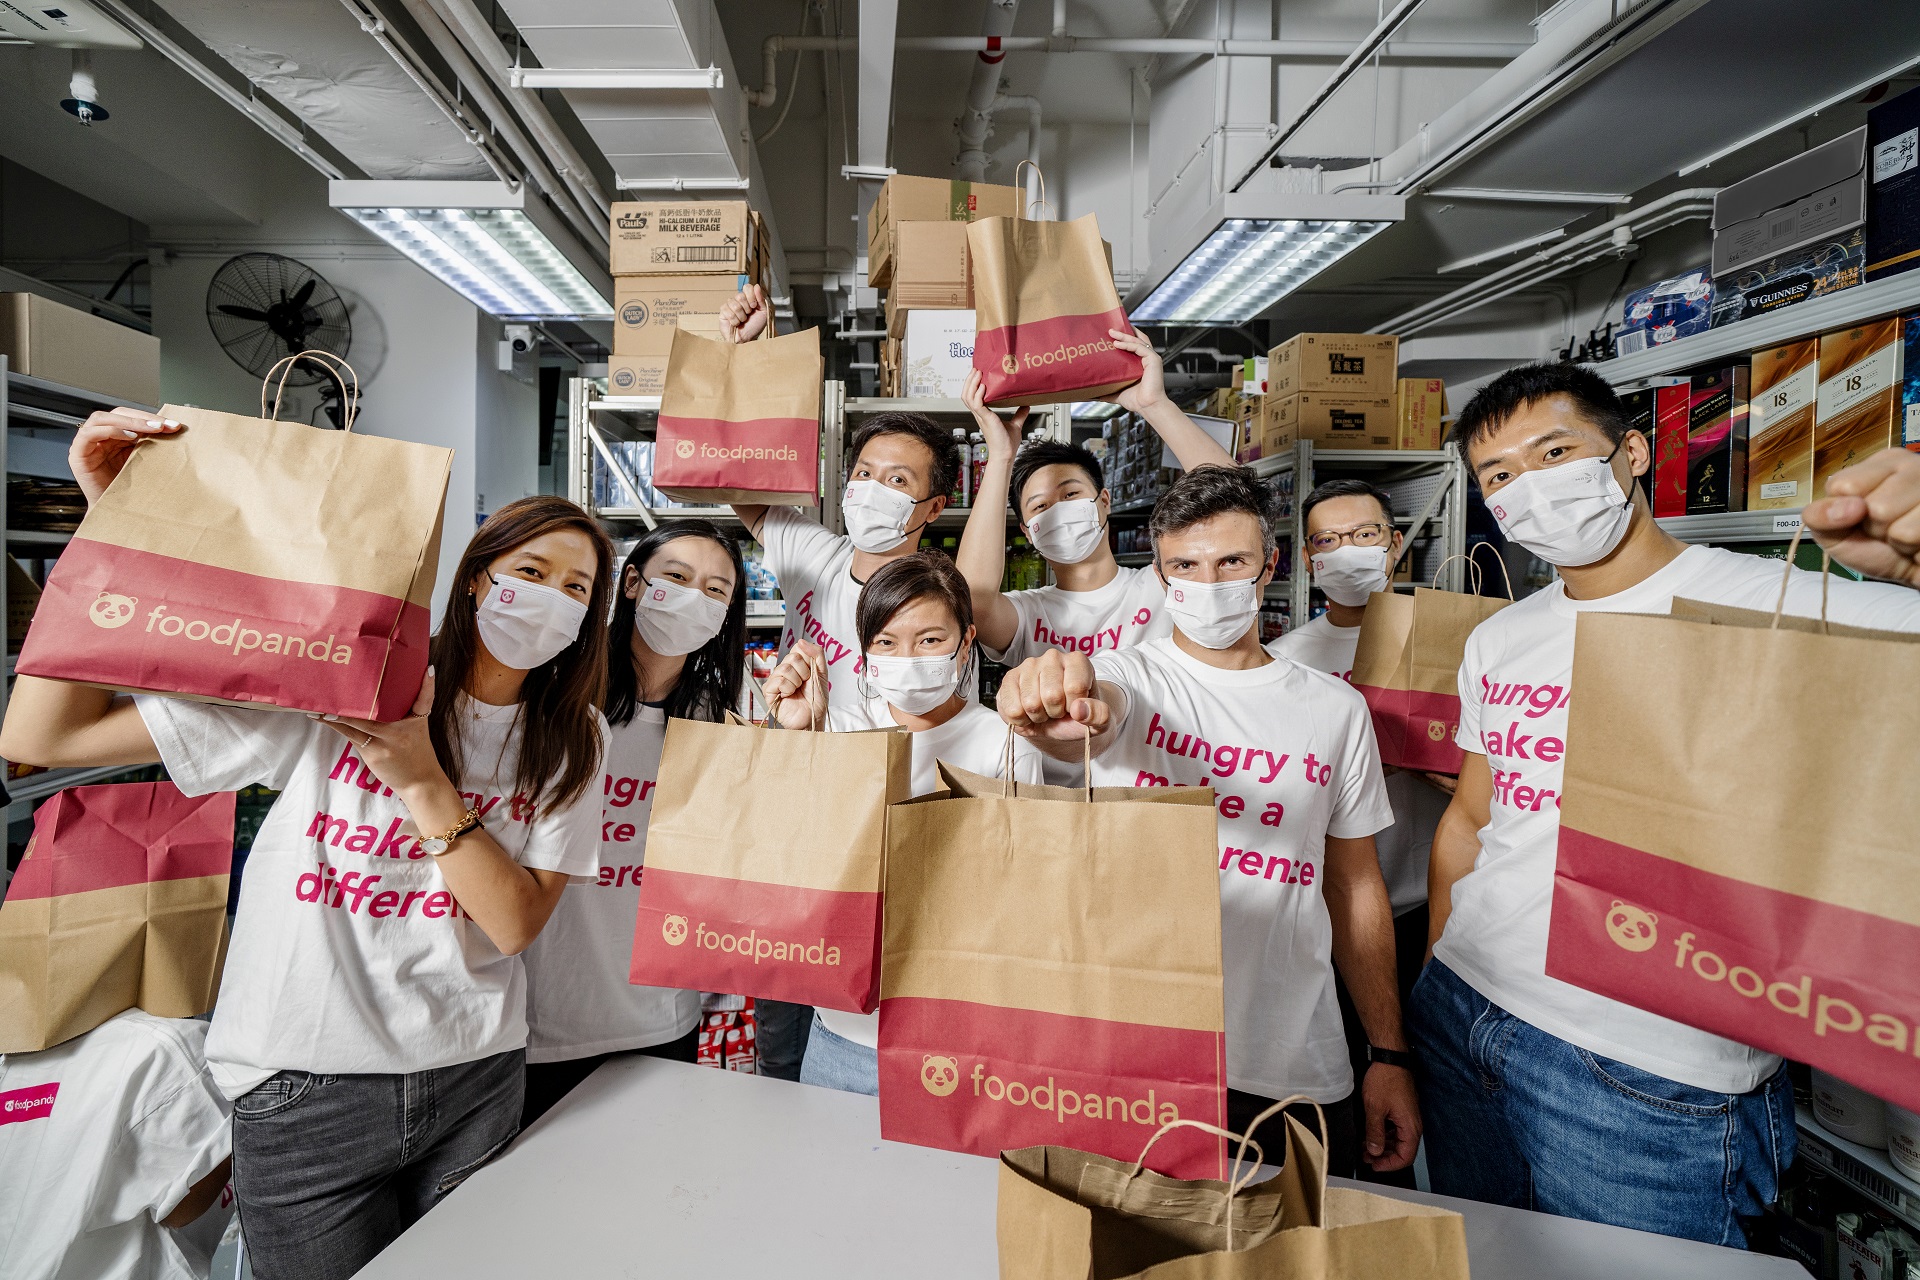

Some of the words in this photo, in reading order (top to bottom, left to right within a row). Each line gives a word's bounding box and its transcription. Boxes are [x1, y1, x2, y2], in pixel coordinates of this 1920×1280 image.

[620, 219, 643, 228] Pauls
[658, 224, 678, 232] MILK
[680, 223, 721, 231] BEVERAGE
[1760, 281, 1809, 304] GUINNESS
[949, 342, 974, 358] Hoe
[1023, 337, 1116, 370] foodpanda
[1846, 375, 1862, 392] 18
[1691, 409, 1709, 422] BLACK
[1711, 398, 1730, 411] LABEL
[1774, 392, 1787, 407] 18
[700, 443, 798, 464] foodpanda
[145, 605, 353, 665] foodpanda
[1145, 712, 1289, 784] hungry
[1303, 752, 1332, 787] to
[1481, 721, 1565, 762] ake
[1259, 801, 1284, 828] a
[695, 922, 841, 966] foodpanda
[1674, 931, 1920, 1059] foodpa
[970, 1063, 1180, 1127] foodpanda
[1838, 1229, 1882, 1268] BEEFEATER
